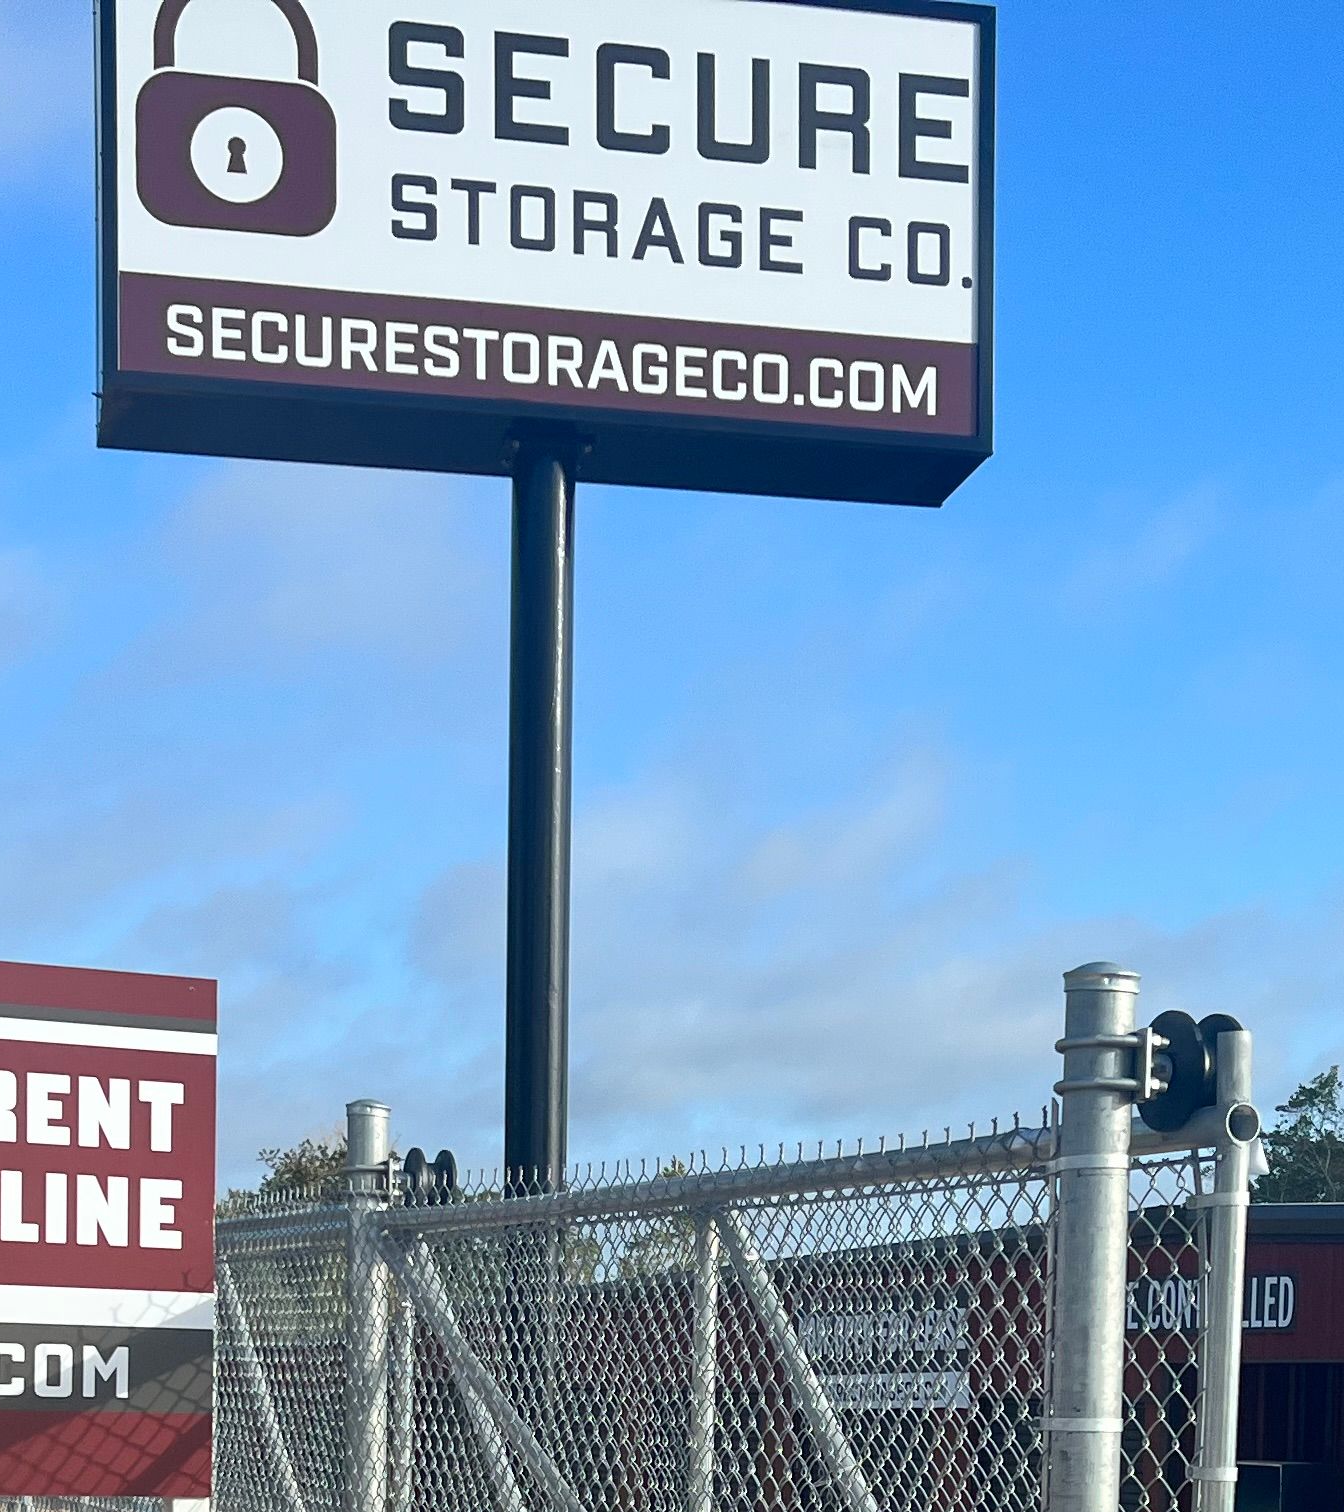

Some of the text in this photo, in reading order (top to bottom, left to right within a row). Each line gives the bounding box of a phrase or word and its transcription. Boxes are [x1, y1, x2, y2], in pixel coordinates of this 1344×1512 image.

[387, 19, 971, 186] SECURE
[389, 172, 974, 290] STORAGE CO.
[166, 303, 938, 417] SECURESTORAGECO.COM
